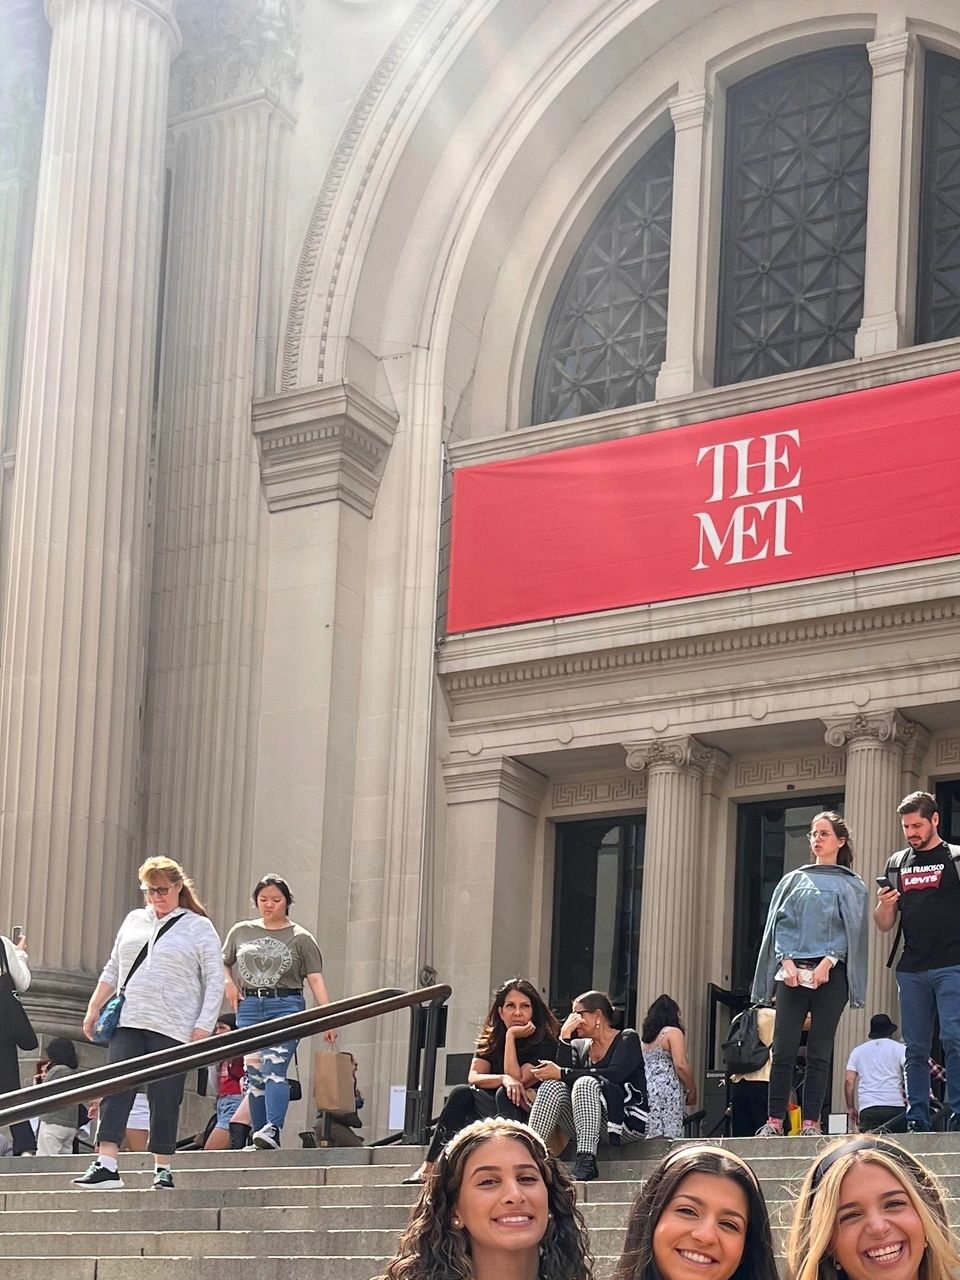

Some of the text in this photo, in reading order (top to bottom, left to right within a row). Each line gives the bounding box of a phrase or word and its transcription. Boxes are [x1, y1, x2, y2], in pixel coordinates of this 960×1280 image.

[696, 429, 802, 504] THE
[690, 495, 803, 571] MET
[901, 864, 944, 875] SAN FRANCISCO
